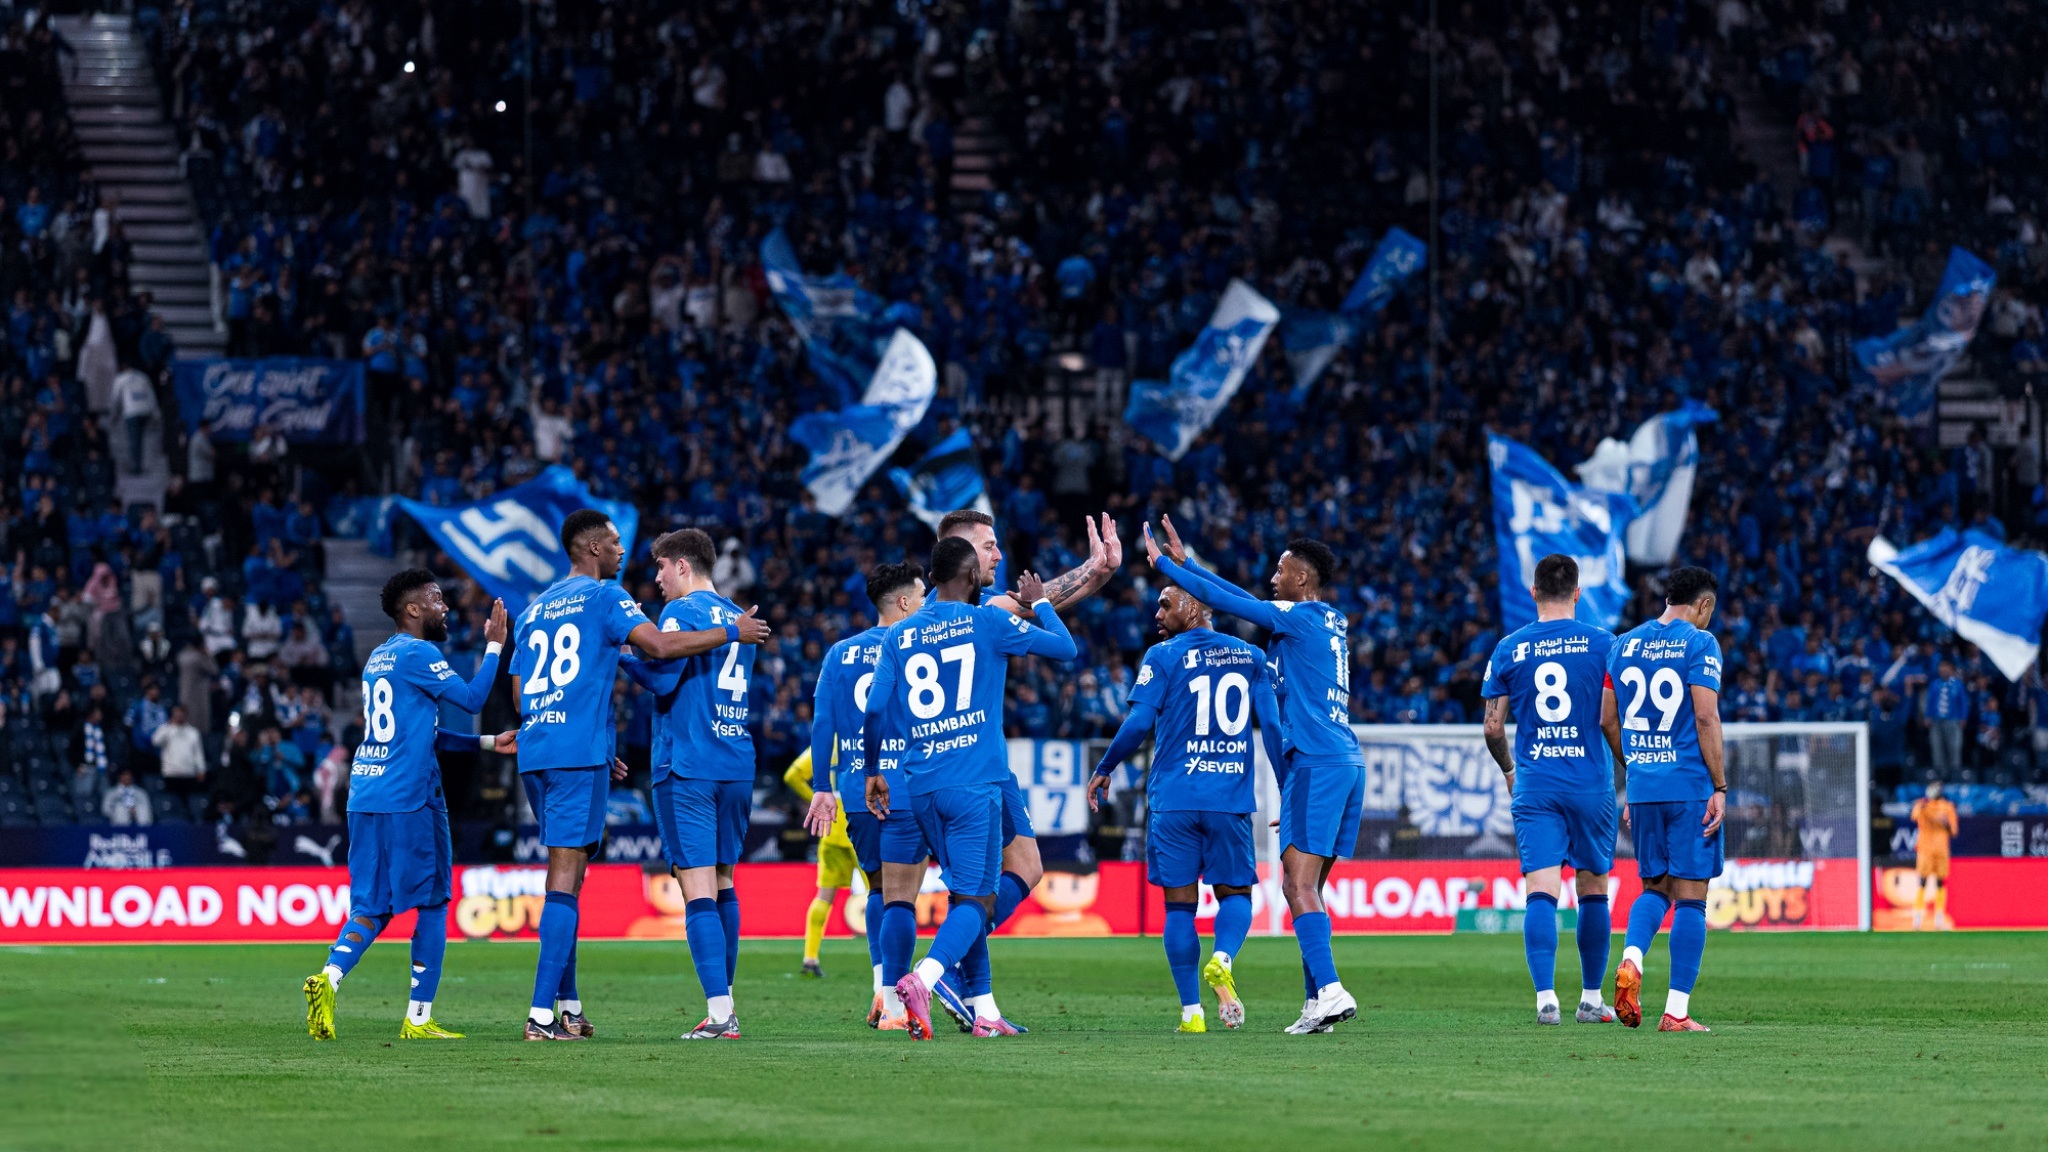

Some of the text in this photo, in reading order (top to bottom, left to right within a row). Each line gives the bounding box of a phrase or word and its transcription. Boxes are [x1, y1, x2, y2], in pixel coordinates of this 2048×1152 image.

[544, 605, 584, 620] Riyad Bank
[921, 615, 973, 635] بنك الرياض
[921, 626, 974, 645] Riyad Bank
[1534, 638, 1562, 648] الرياض
[523, 622, 580, 694] 28
[1534, 645, 1588, 657] Riyad Bank
[1641, 649, 1685, 661] Riyad Bank
[1205, 656, 1253, 667] Riyad Bank
[1329, 636, 1350, 693] 1
[717, 641, 748, 702] 4
[904, 642, 976, 719] 87
[1534, 661, 1572, 722] 8
[1620, 666, 1684, 731] 29
[715, 703, 748, 720] YUSUF
[1188, 672, 1250, 736] 10
[911, 709, 986, 739] ALTAMBAKTI
[1537, 726, 1578, 739] NEVES
[936, 734, 978, 754] SEVEN
[1186, 740, 1247, 753] MALCOM
[1630, 733, 1672, 748] SALEM
[1543, 746, 1585, 757] SEVEN
[1637, 750, 1677, 764] SEVEN
[352, 763, 386, 776] SEVEN
[854, 758, 898, 770] SEN
[1042, 740, 1074, 788] 9
[1198, 760, 1244, 774] SEVEN
[1047, 790, 1067, 829] 7
[456, 894, 547, 937] GUY
[1706, 886, 1809, 928] GUYS
